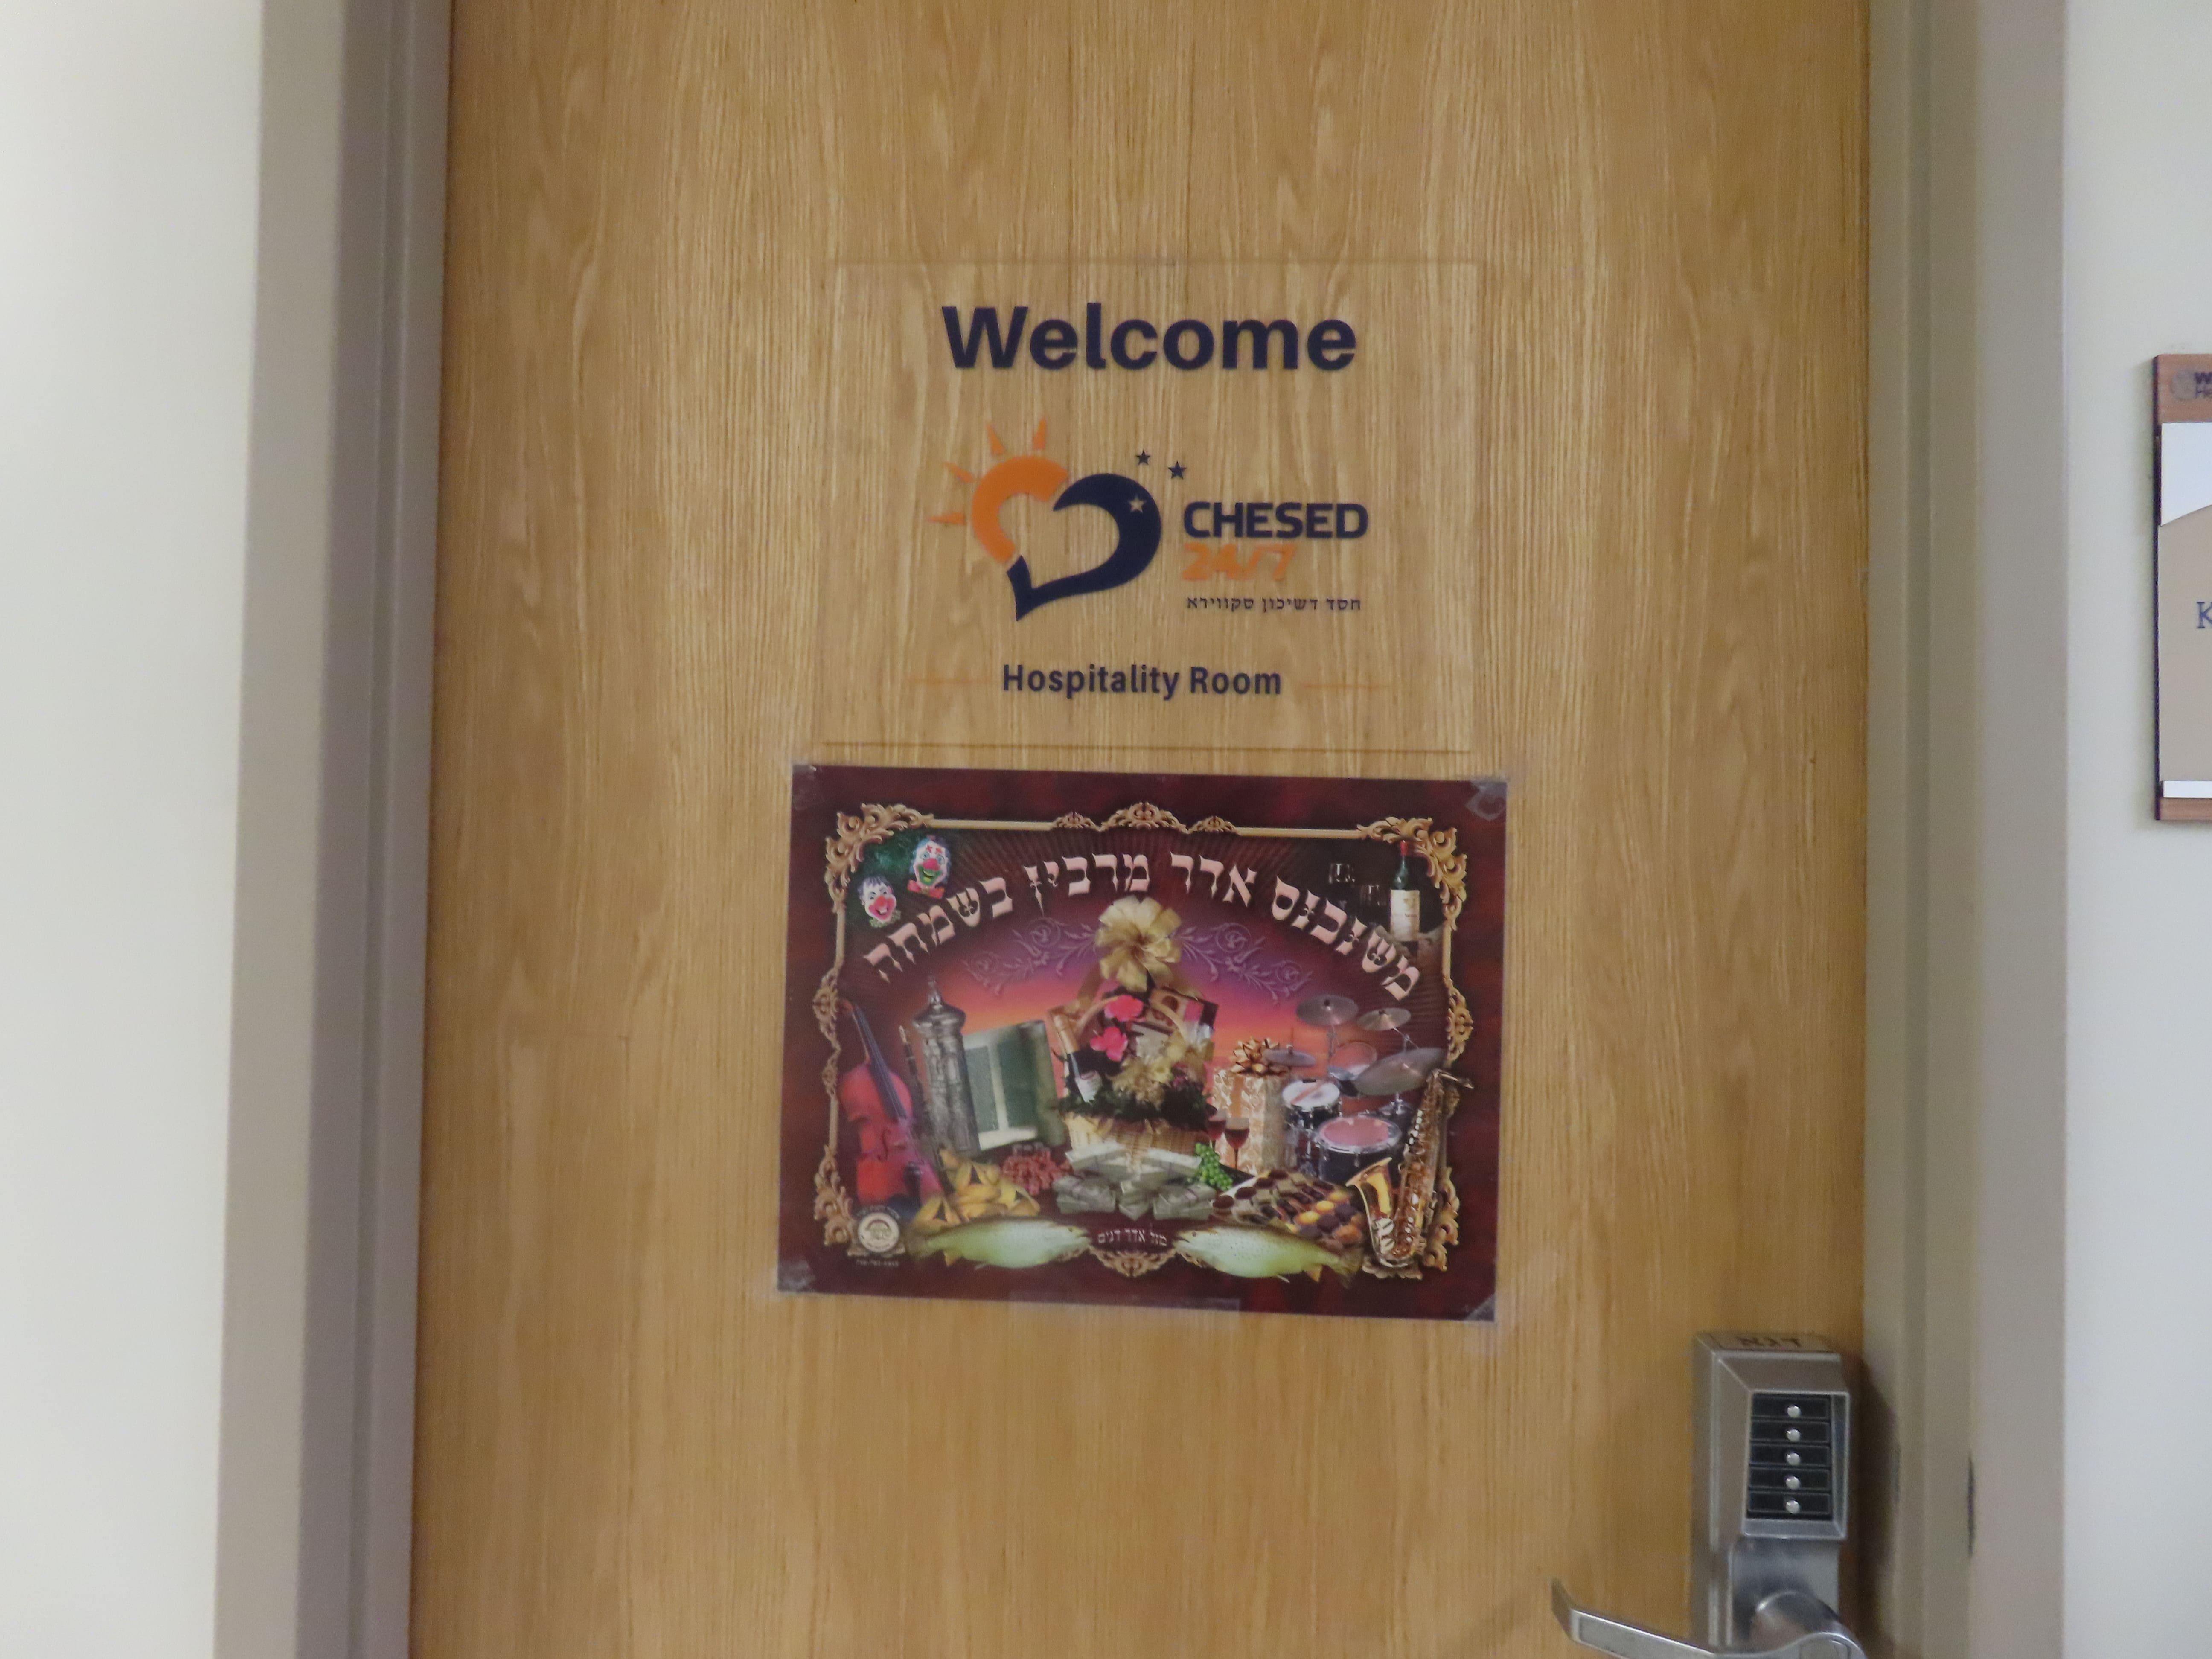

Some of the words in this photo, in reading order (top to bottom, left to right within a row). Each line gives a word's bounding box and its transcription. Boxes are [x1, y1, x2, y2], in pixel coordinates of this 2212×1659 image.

[941, 302, 1357, 370] Welcome
[1183, 501, 1369, 539] CHESED
[1182, 542, 1296, 580] 24/7
[1186, 596, 1255, 613] סקווירא
[1262, 597, 1318, 614] דשיכון
[1326, 598, 1361, 611] חסד
[1003, 664, 1181, 701] Hospitality
[1190, 667, 1282, 696] Room
[1023, 853, 1150, 916] מרבין
[1170, 851, 1257, 907] אדר
[863, 876, 1013, 984] בשמחה
[1272, 876, 1420, 1001] משנכנס
